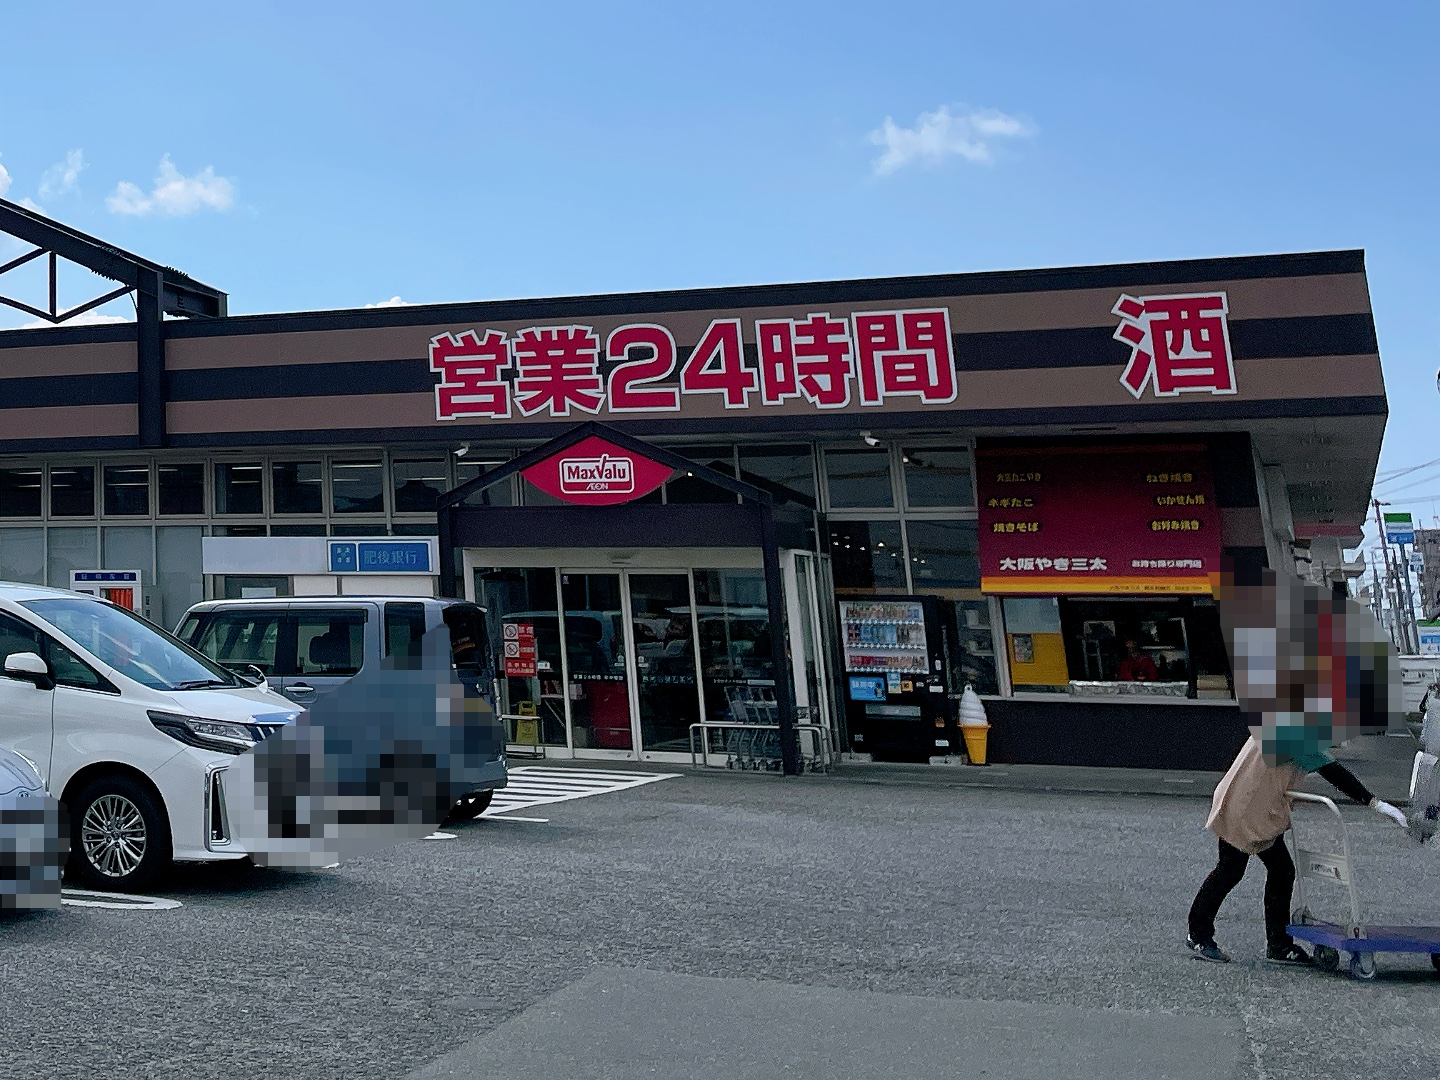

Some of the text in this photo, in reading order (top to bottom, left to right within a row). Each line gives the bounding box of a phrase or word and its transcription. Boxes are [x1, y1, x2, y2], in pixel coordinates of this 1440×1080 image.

[1111, 291, 1238, 400] 酒
[429, 307, 958, 420] 営業24時間
[567, 456, 626, 479] MaxValu
[364, 550, 417, 565] 肥後銀行
[999, 557, 1108, 571] 大阪やき三太
